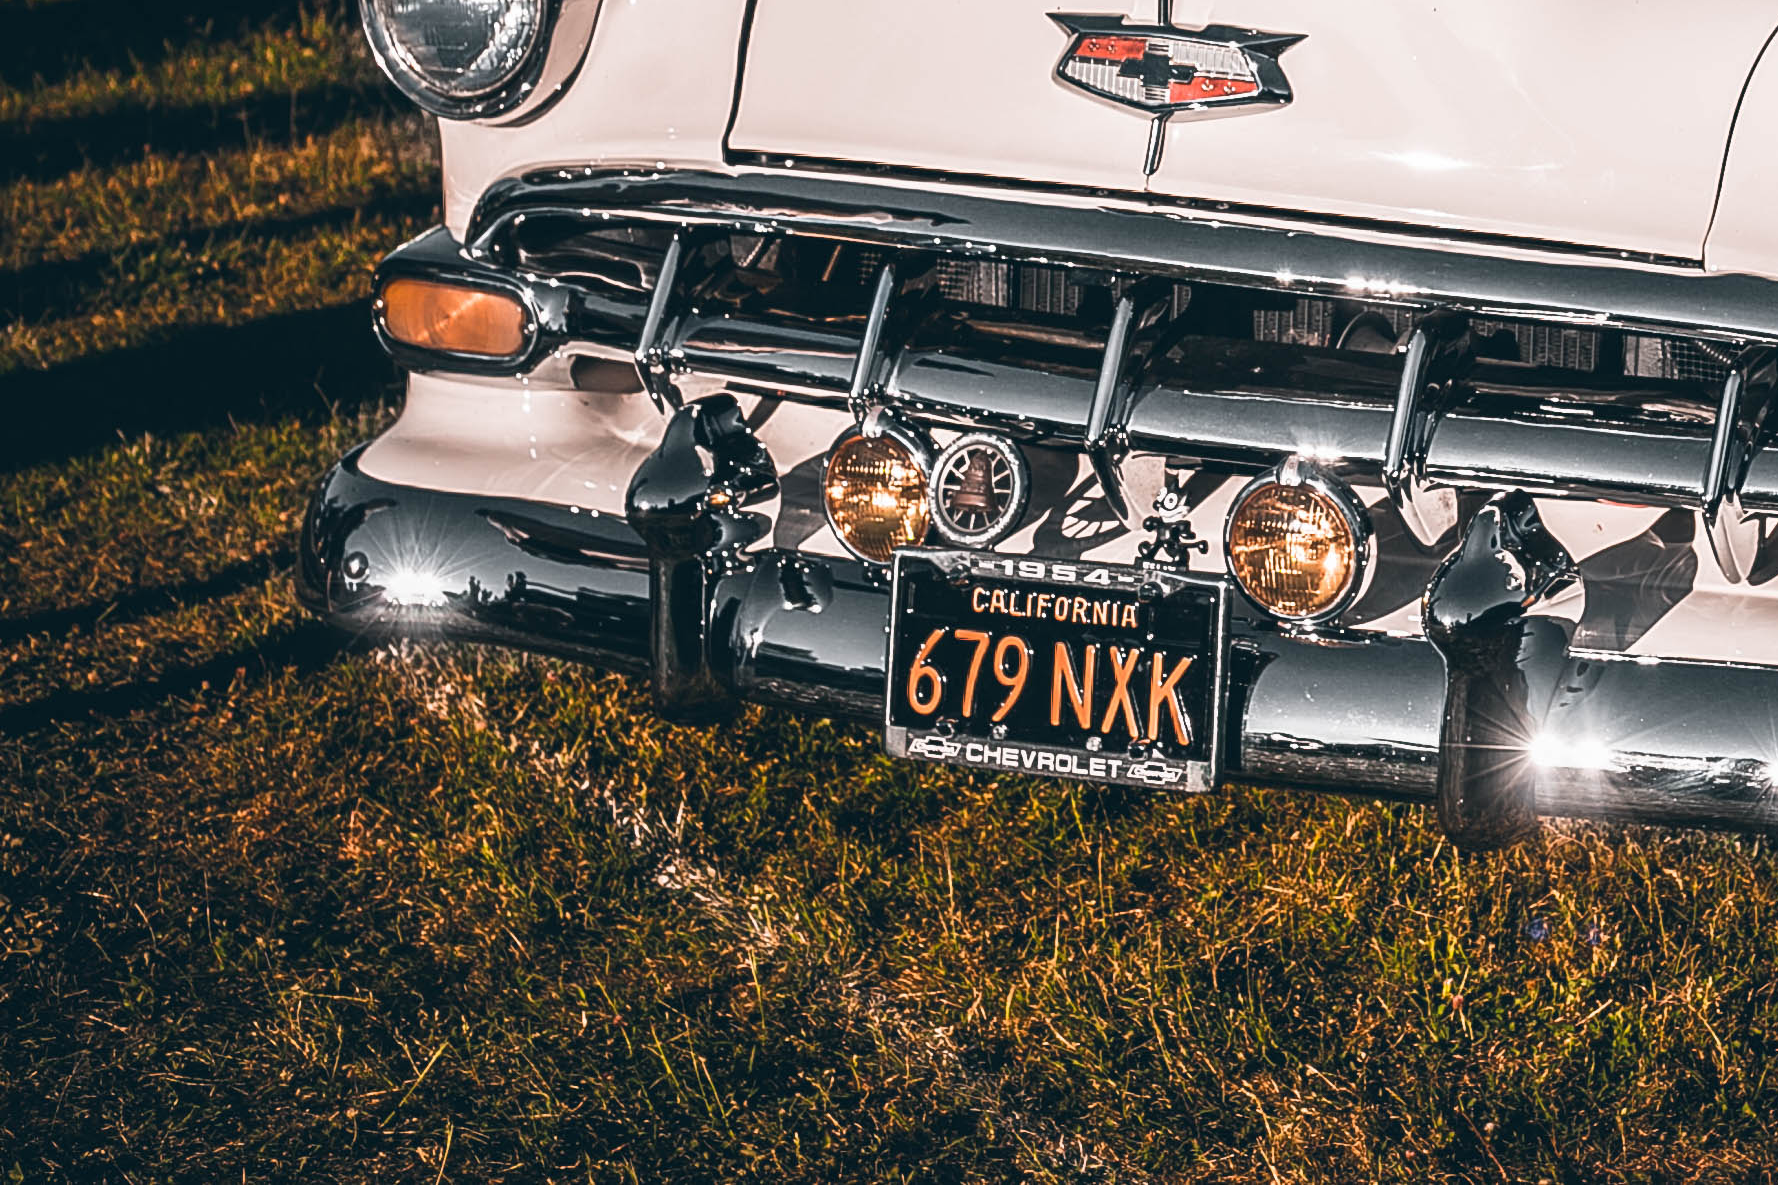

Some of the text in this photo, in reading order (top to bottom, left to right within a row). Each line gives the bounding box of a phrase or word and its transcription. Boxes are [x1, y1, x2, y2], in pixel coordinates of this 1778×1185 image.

[972, 586, 1139, 628] CALIFORNIA
[907, 628, 1194, 746] 679 NXK
[966, 743, 1123, 778] CHEVROLET
